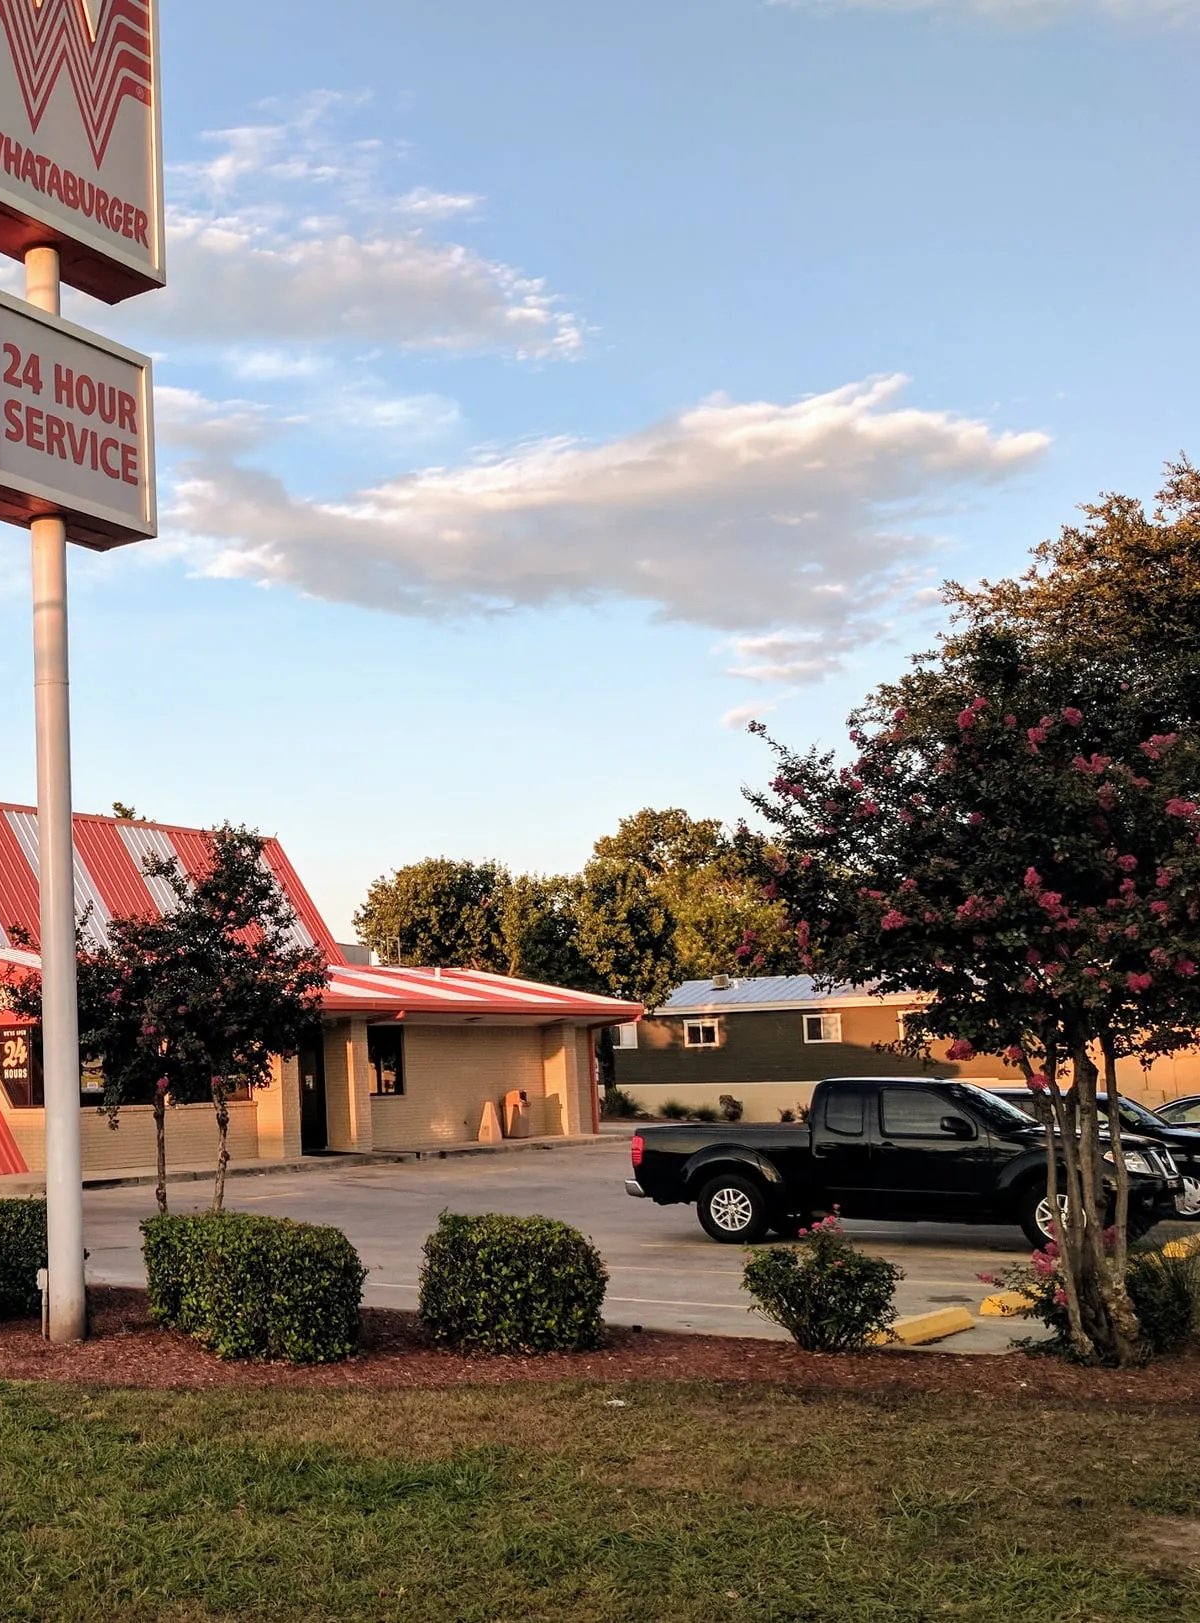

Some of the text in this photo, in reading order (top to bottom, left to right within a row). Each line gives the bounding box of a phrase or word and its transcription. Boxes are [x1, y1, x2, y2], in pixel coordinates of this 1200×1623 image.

[3, 342, 138, 435] 24 HOUR
[4, 399, 139, 486] SERVICE
[2, 1036, 28, 1068] 24
[4, 1068, 28, 1079] HOURS
